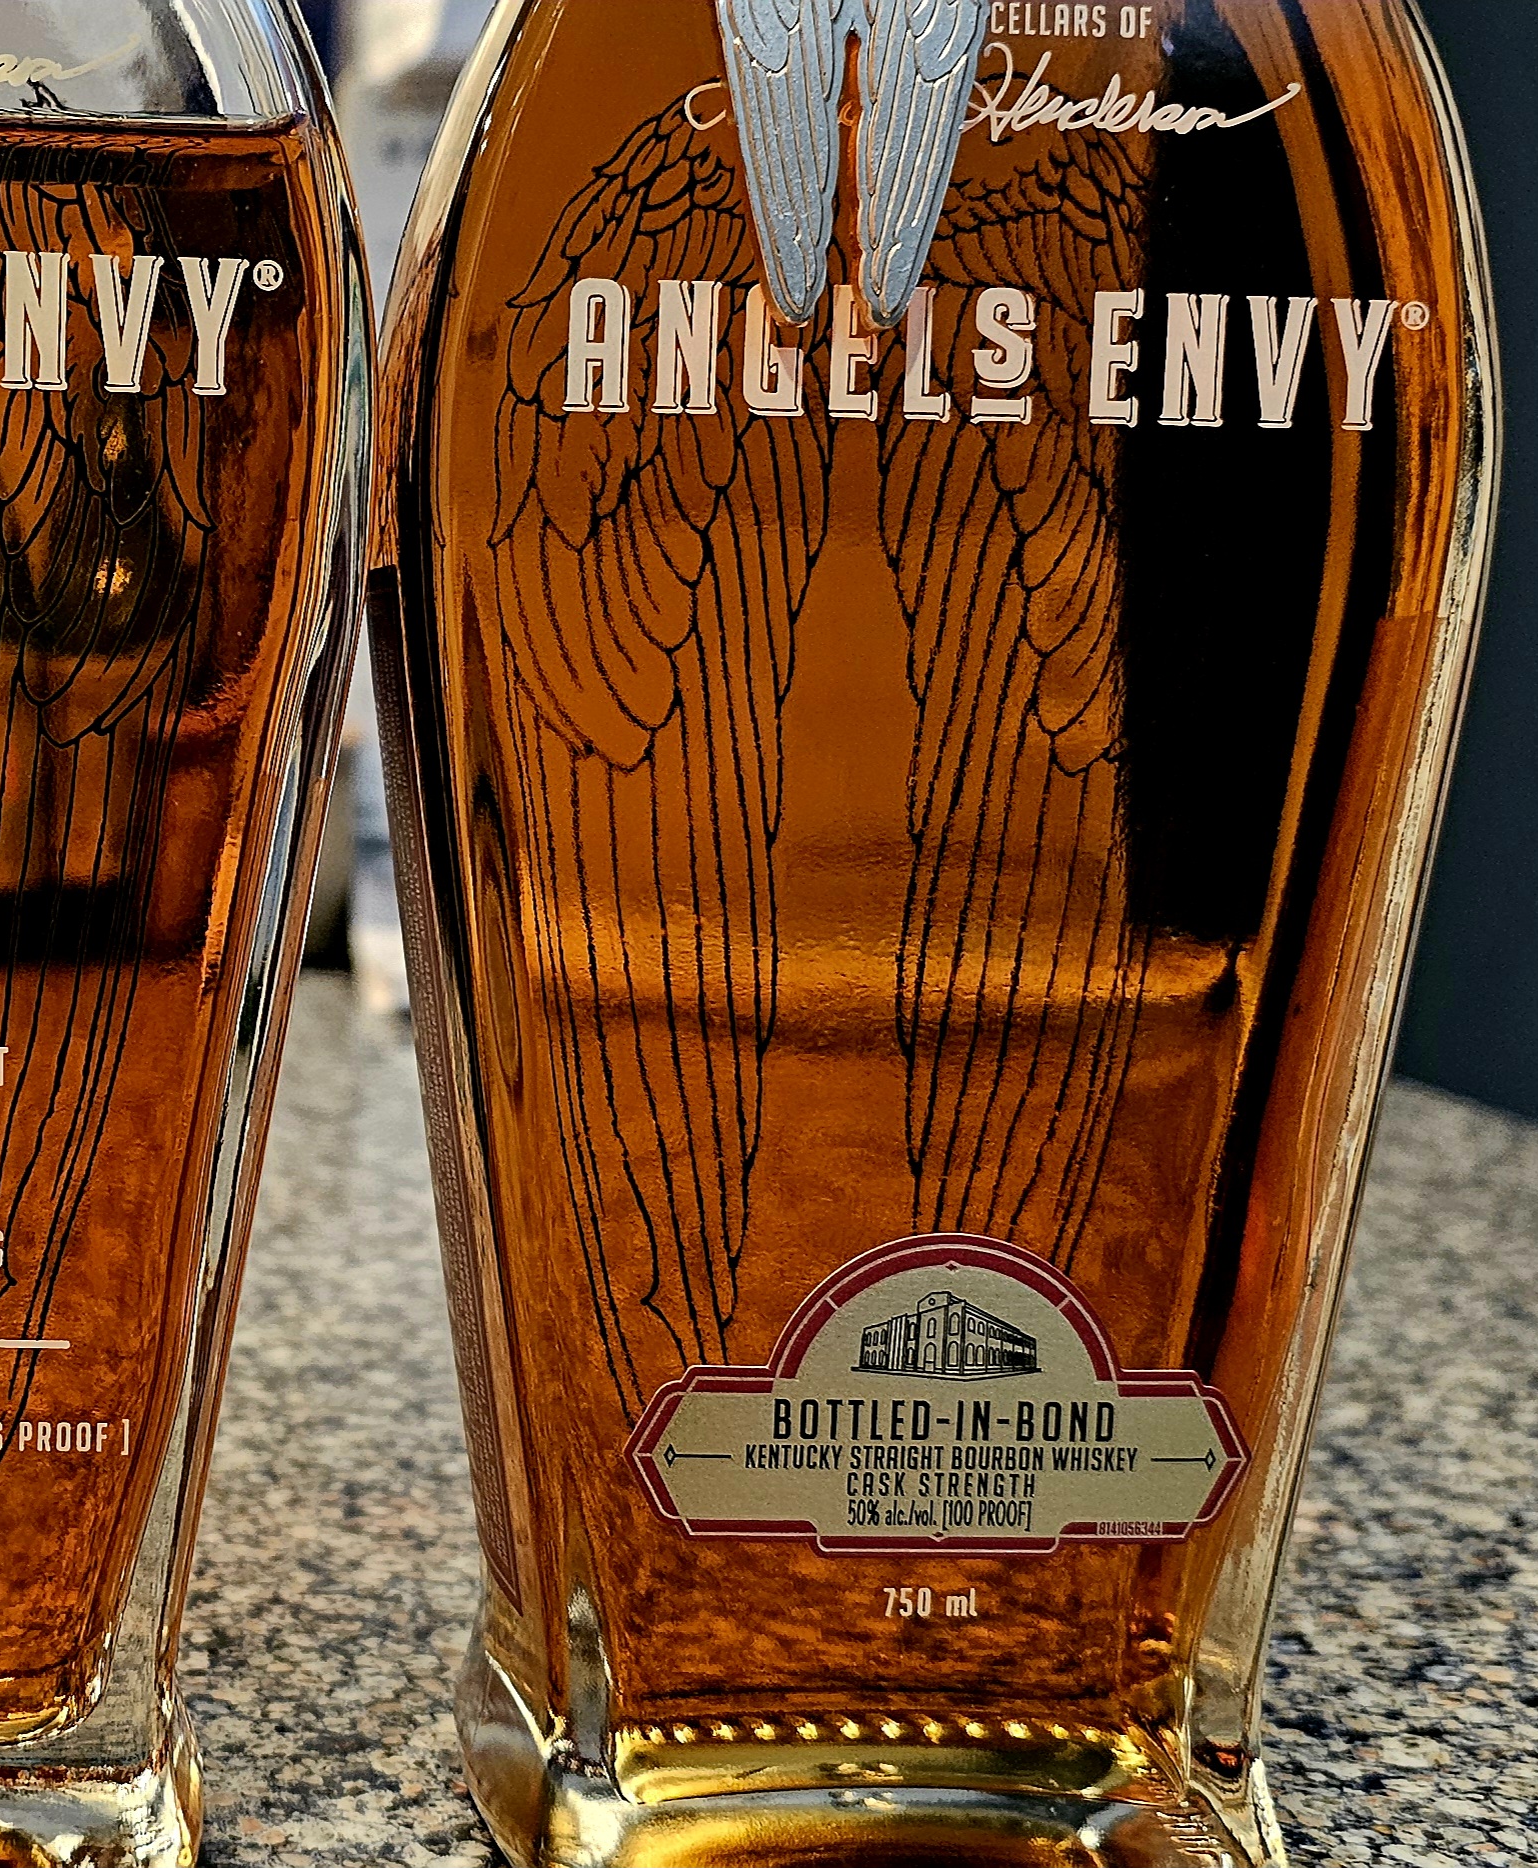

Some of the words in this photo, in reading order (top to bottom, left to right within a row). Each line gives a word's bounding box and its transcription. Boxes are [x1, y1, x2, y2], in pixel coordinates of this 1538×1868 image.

[989, 1, 1107, 38] CELLARS
[1119, 5, 1153, 39] OF
[772, 1398, 1115, 1442] BOTTLED-IN-BOND
[744, 1444, 842, 1470] KENTUCKY
[849, 1445, 944, 1470] STRAIGHT
[951, 1446, 1043, 1471] BOURBON
[1052, 1447, 1138, 1472] WHISKEY
[846, 1472, 905, 1497] CASK
[918, 1473, 1036, 1498] STRENGTH
[846, 1500, 879, 1527] 50%
[885, 1500, 937, 1527] alc./vol.
[978, 1501, 1032, 1531] PROOF]
[883, 1587, 932, 1618] 750
[945, 1587, 979, 1618] ml
